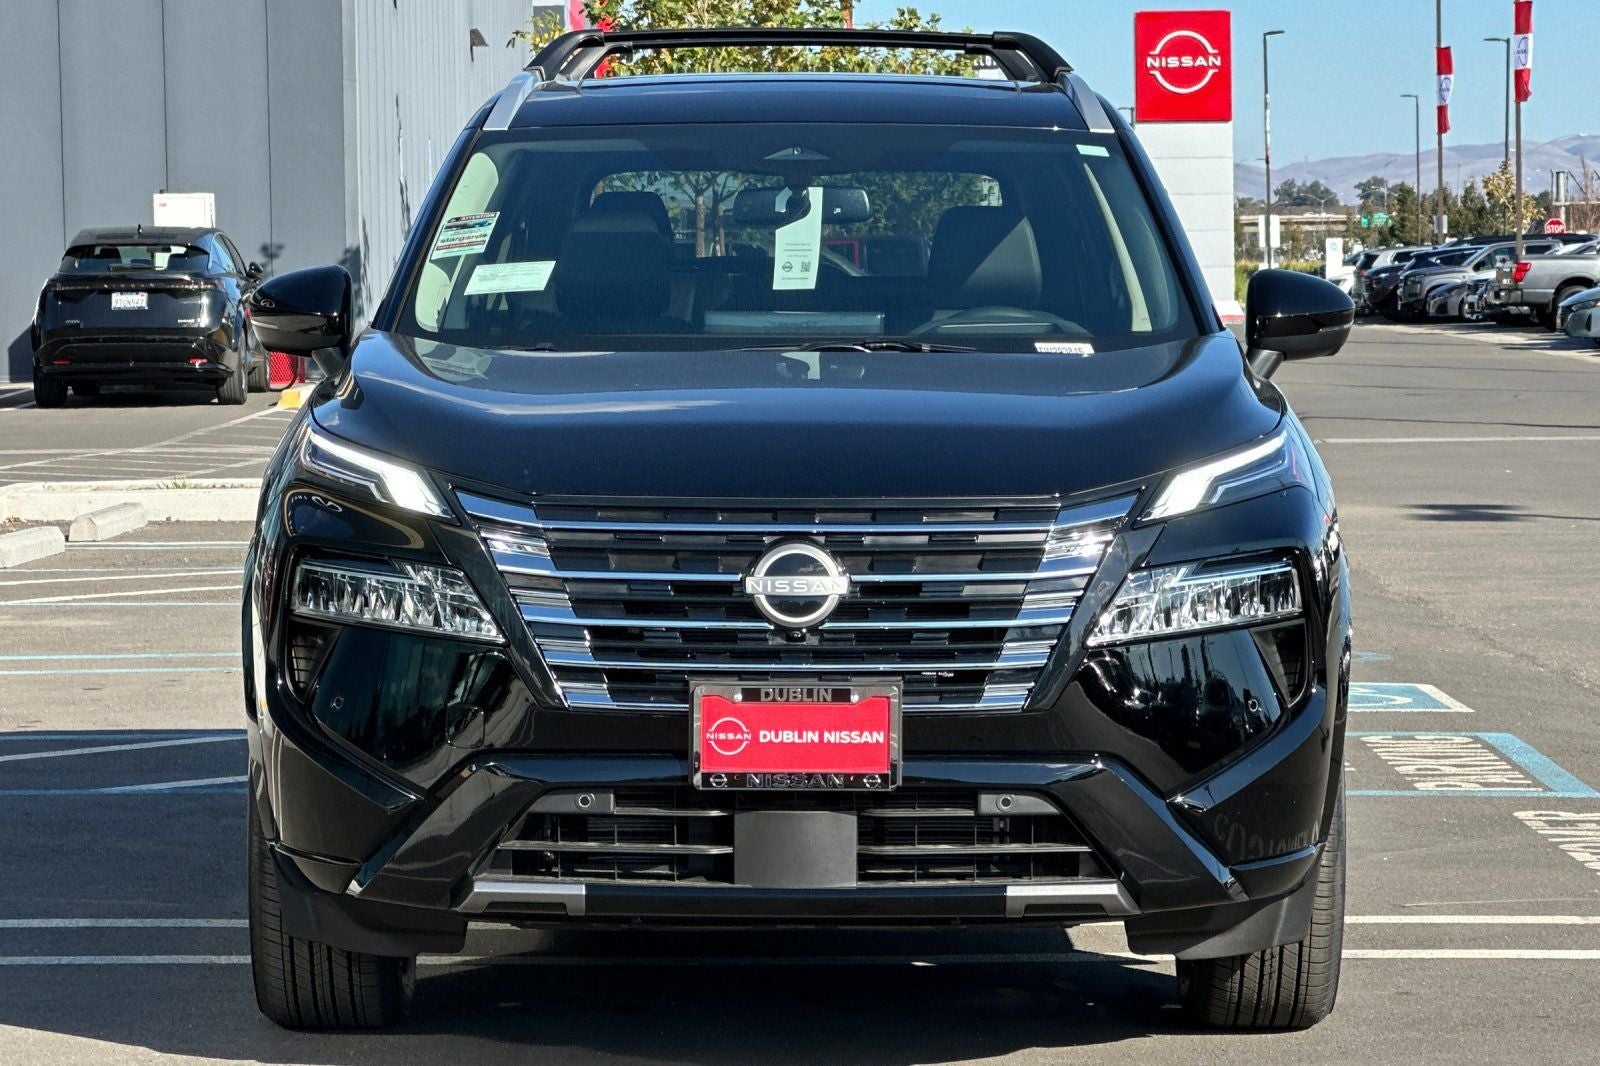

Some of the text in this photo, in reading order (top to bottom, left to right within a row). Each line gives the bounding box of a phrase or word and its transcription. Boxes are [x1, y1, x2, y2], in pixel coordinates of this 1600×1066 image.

[1146, 55, 1222, 68] NISSAN
[1546, 225, 1564, 233] STOP
[748, 580, 846, 593] NISSAN
[760, 687, 833, 702] DUBLIN
[706, 732, 751, 741] NISSAN
[759, 730, 885, 744] DUBLIN NISSAN
[1359, 734, 1544, 792] PARKING
[746, 773, 845, 788] NISSAN
